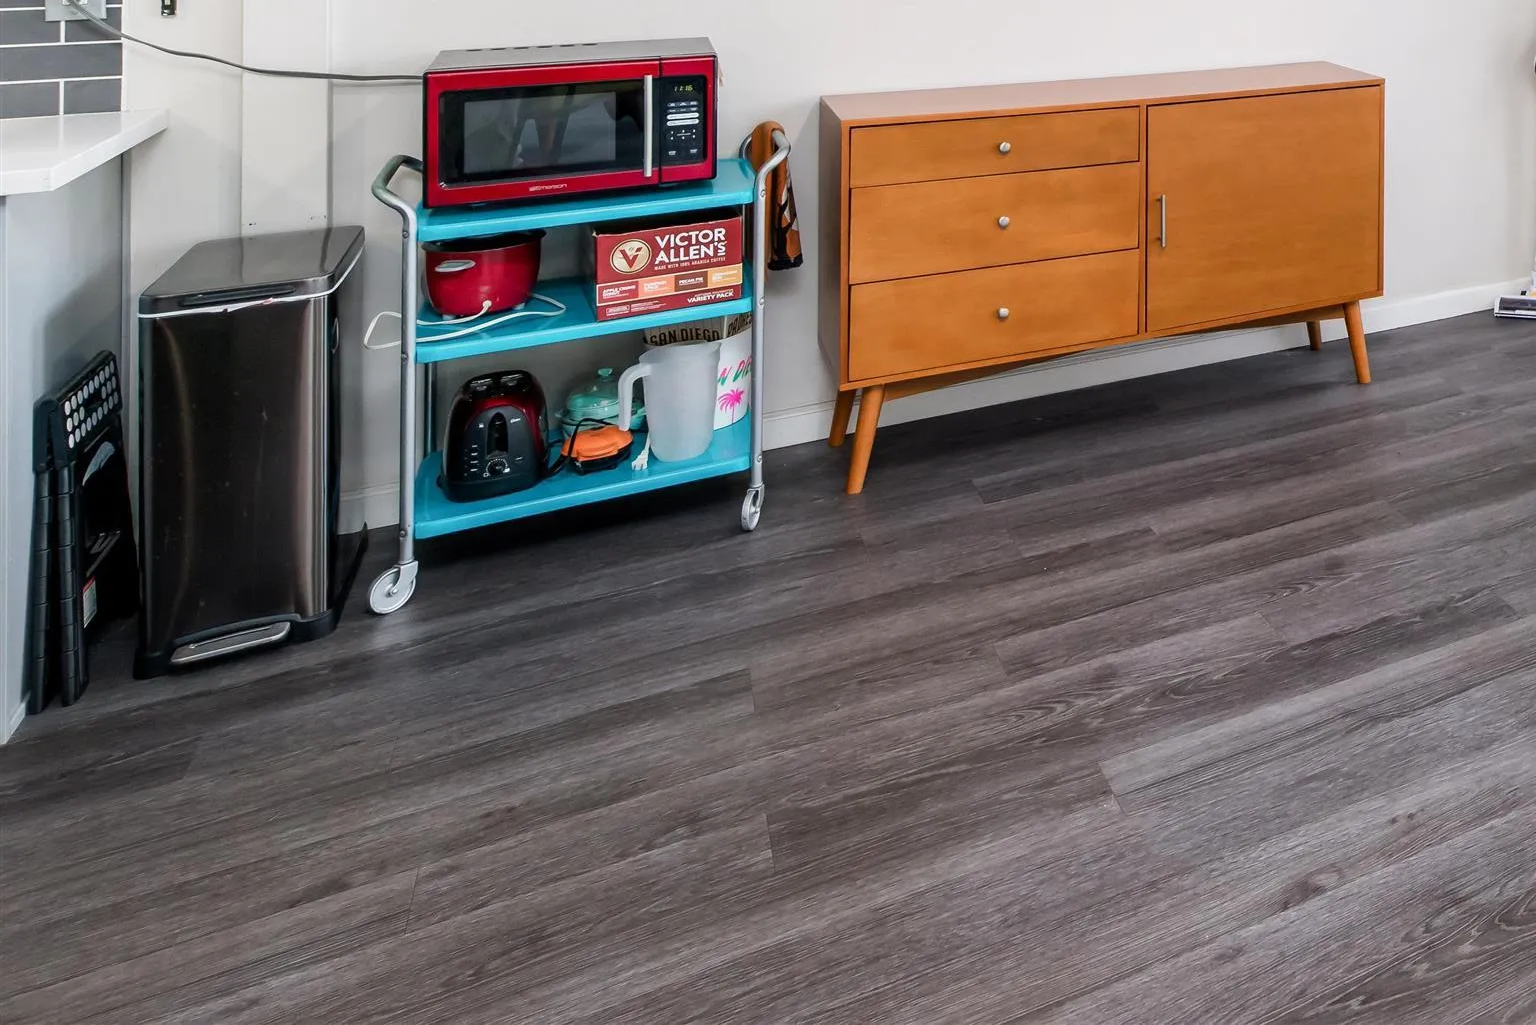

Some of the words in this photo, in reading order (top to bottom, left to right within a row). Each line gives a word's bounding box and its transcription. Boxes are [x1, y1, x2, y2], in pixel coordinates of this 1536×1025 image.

[655, 228, 726, 249] VICTOR
[654, 241, 728, 265] ALLEN'S
[687, 294, 715, 304] VARIETY
[716, 291, 734, 299] PACK
[649, 329, 677, 346] SAN
[680, 327, 720, 343] DIEGO
